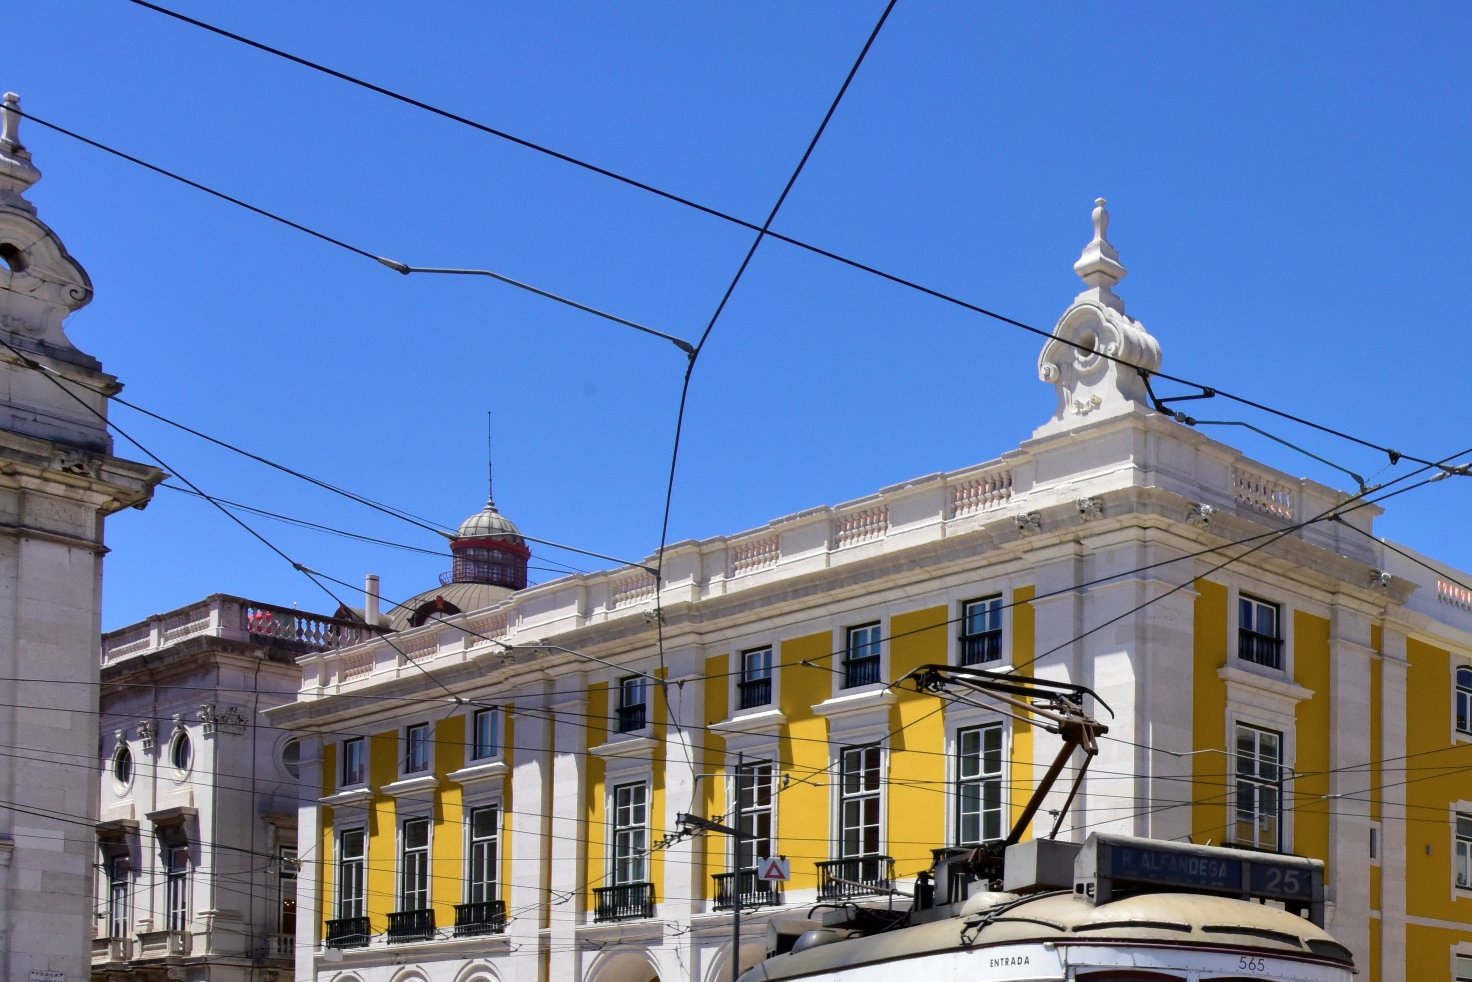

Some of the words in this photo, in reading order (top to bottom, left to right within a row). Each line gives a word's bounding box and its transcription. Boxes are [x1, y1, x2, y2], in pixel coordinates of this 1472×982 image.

[1142, 852, 1228, 878] ALFANDEGA
[1265, 868, 1300, 894] 25
[989, 955, 1031, 968] ENTRADA
[1238, 956, 1266, 972] 565
